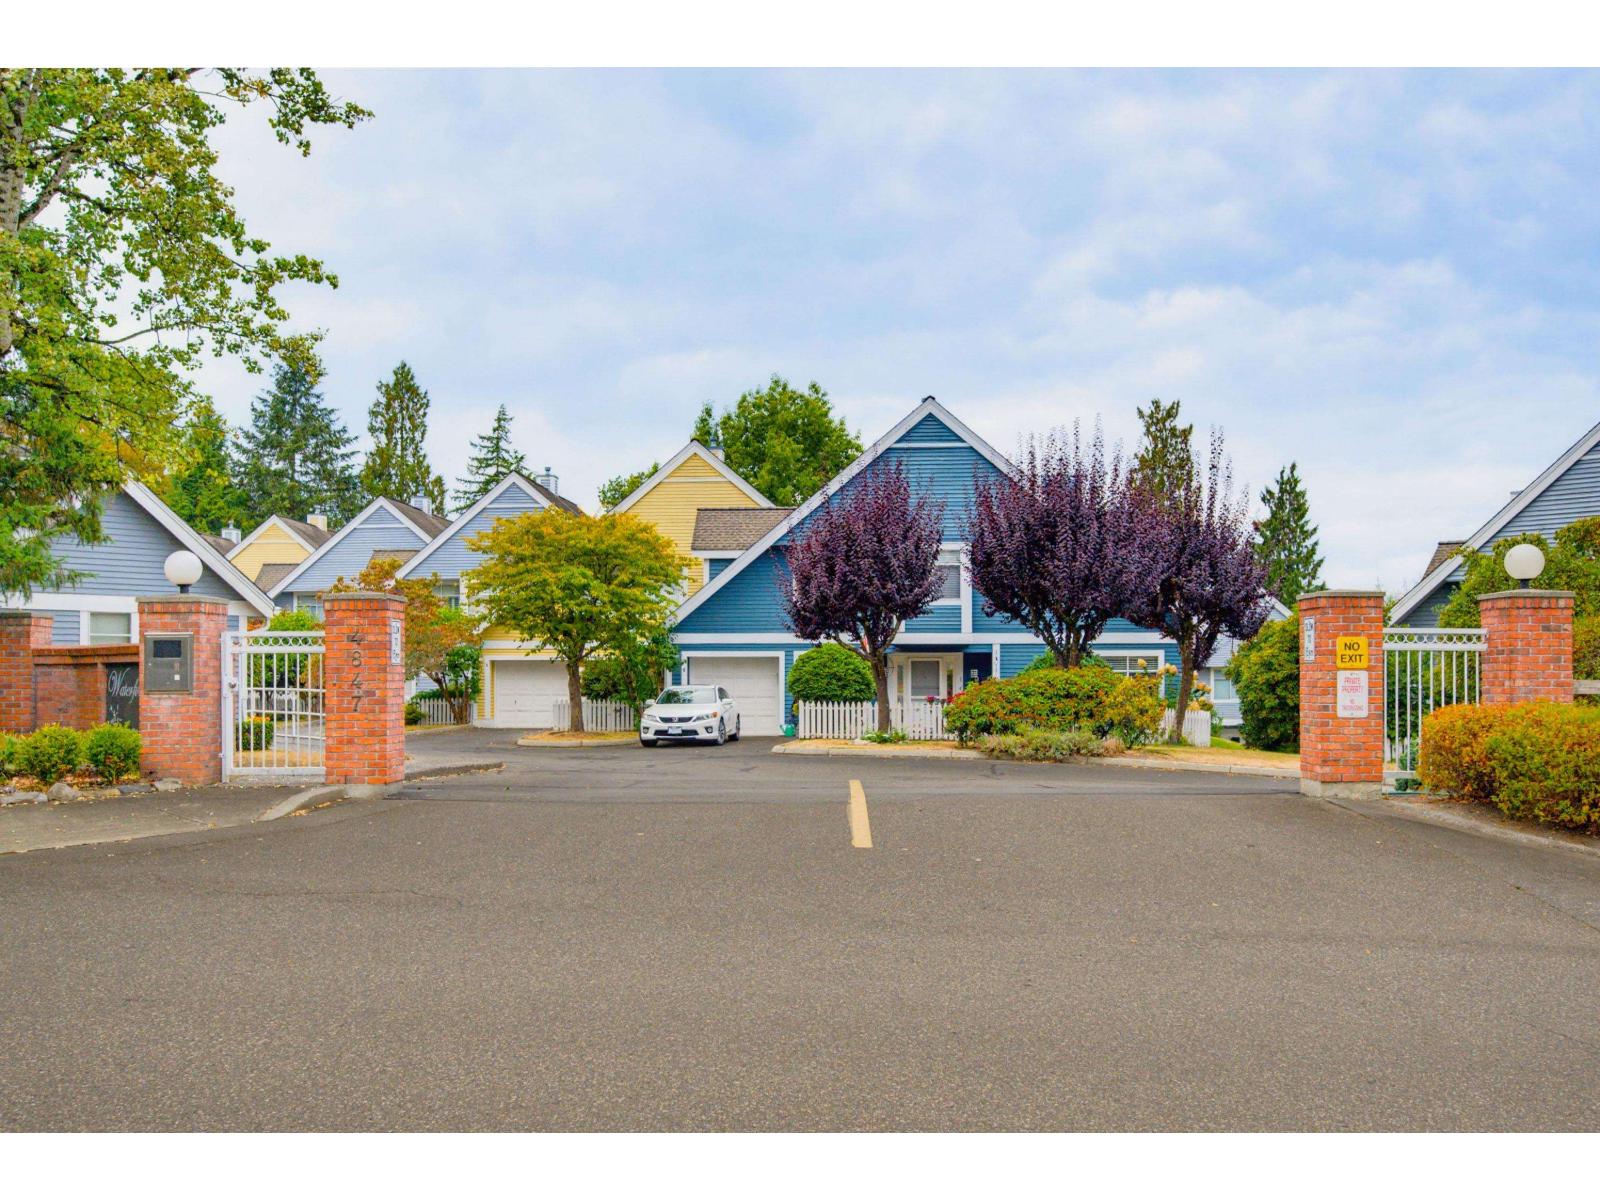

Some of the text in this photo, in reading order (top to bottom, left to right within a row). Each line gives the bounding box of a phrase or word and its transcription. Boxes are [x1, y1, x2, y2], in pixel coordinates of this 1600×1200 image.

[1344, 642, 1360, 651] NO
[1340, 654, 1363, 663] EXIT
[351, 630, 363, 712] 4847
